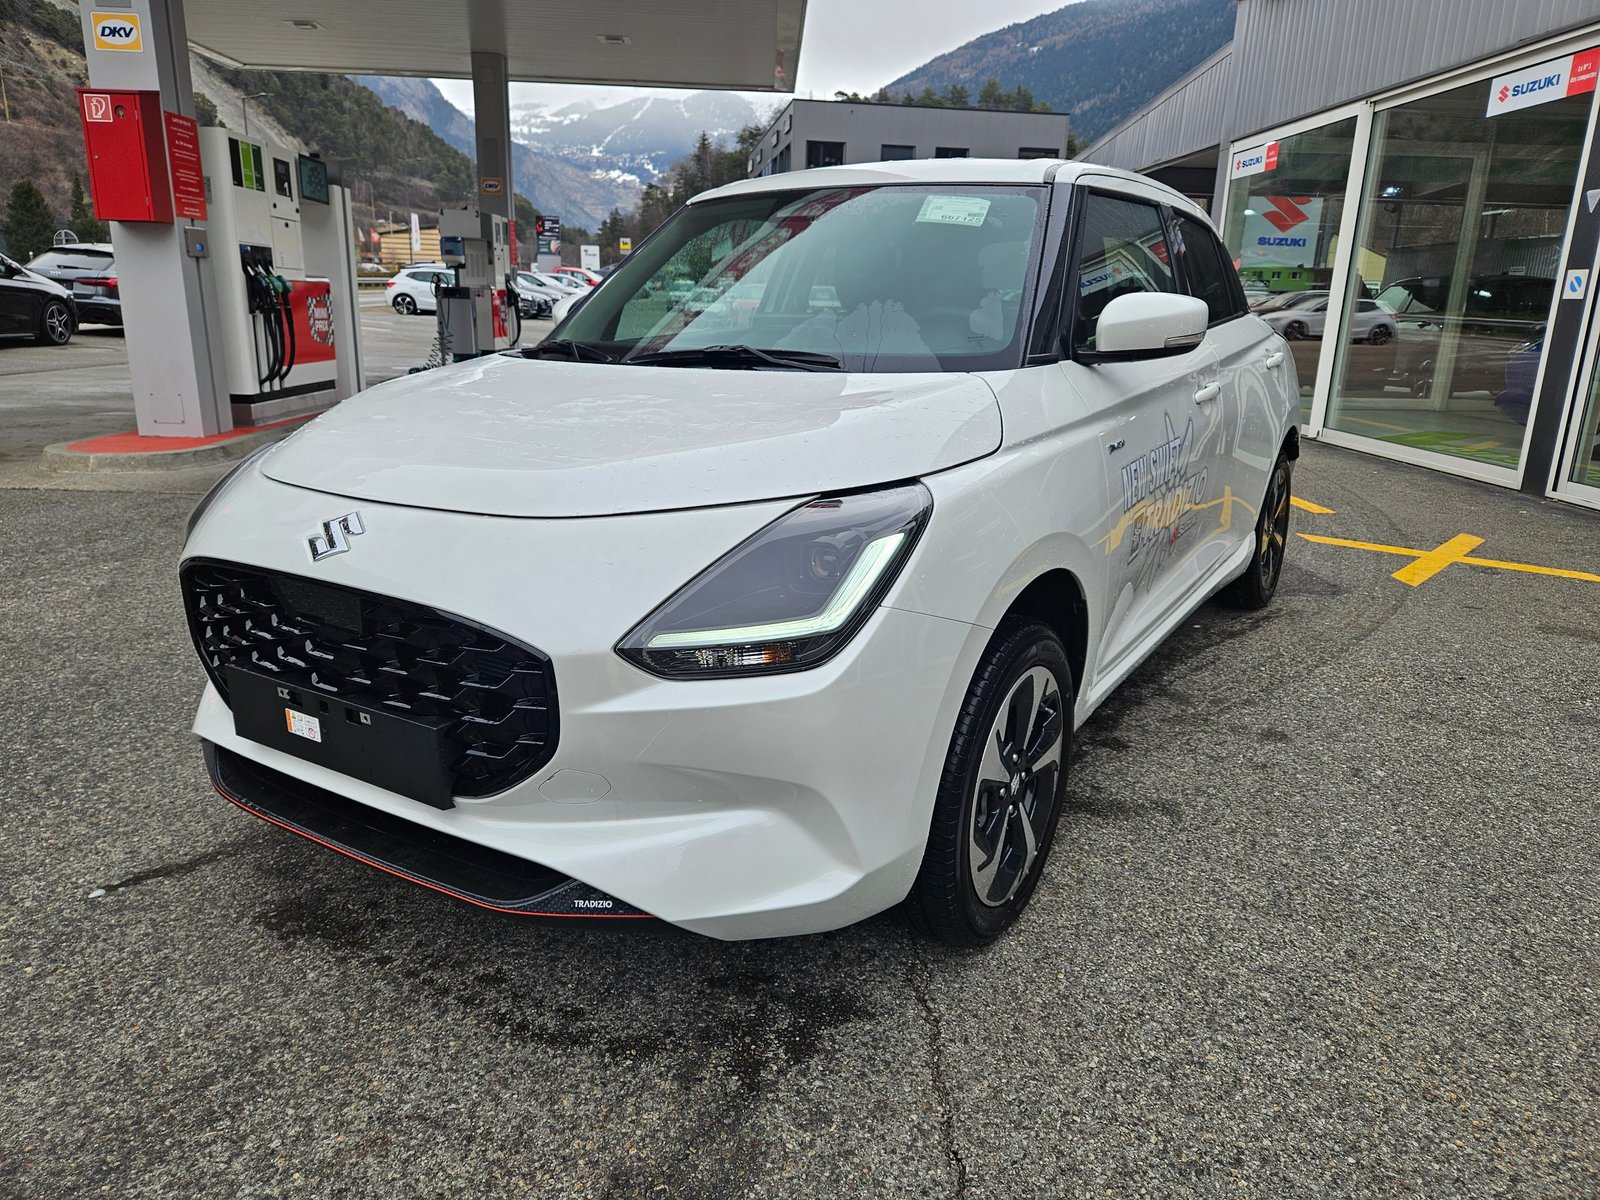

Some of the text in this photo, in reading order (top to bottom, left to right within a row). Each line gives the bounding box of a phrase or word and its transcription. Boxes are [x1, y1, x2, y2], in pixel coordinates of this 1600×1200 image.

[100, 26, 134, 38] DKV
[1511, 73, 1561, 97] SUZUKI
[1242, 156, 1263, 168] SUZUKI
[283, 181, 290, 196] 1
[484, 182, 500, 190] DKV
[1257, 236, 1306, 247] SUZUKI
[314, 307, 329, 319] MINI
[314, 319, 329, 331] PRIX
[1121, 437, 1181, 513] NEW SWIFT
[1142, 466, 1208, 547] TRADIZIO
[574, 900, 613, 908] TRADIZIO
